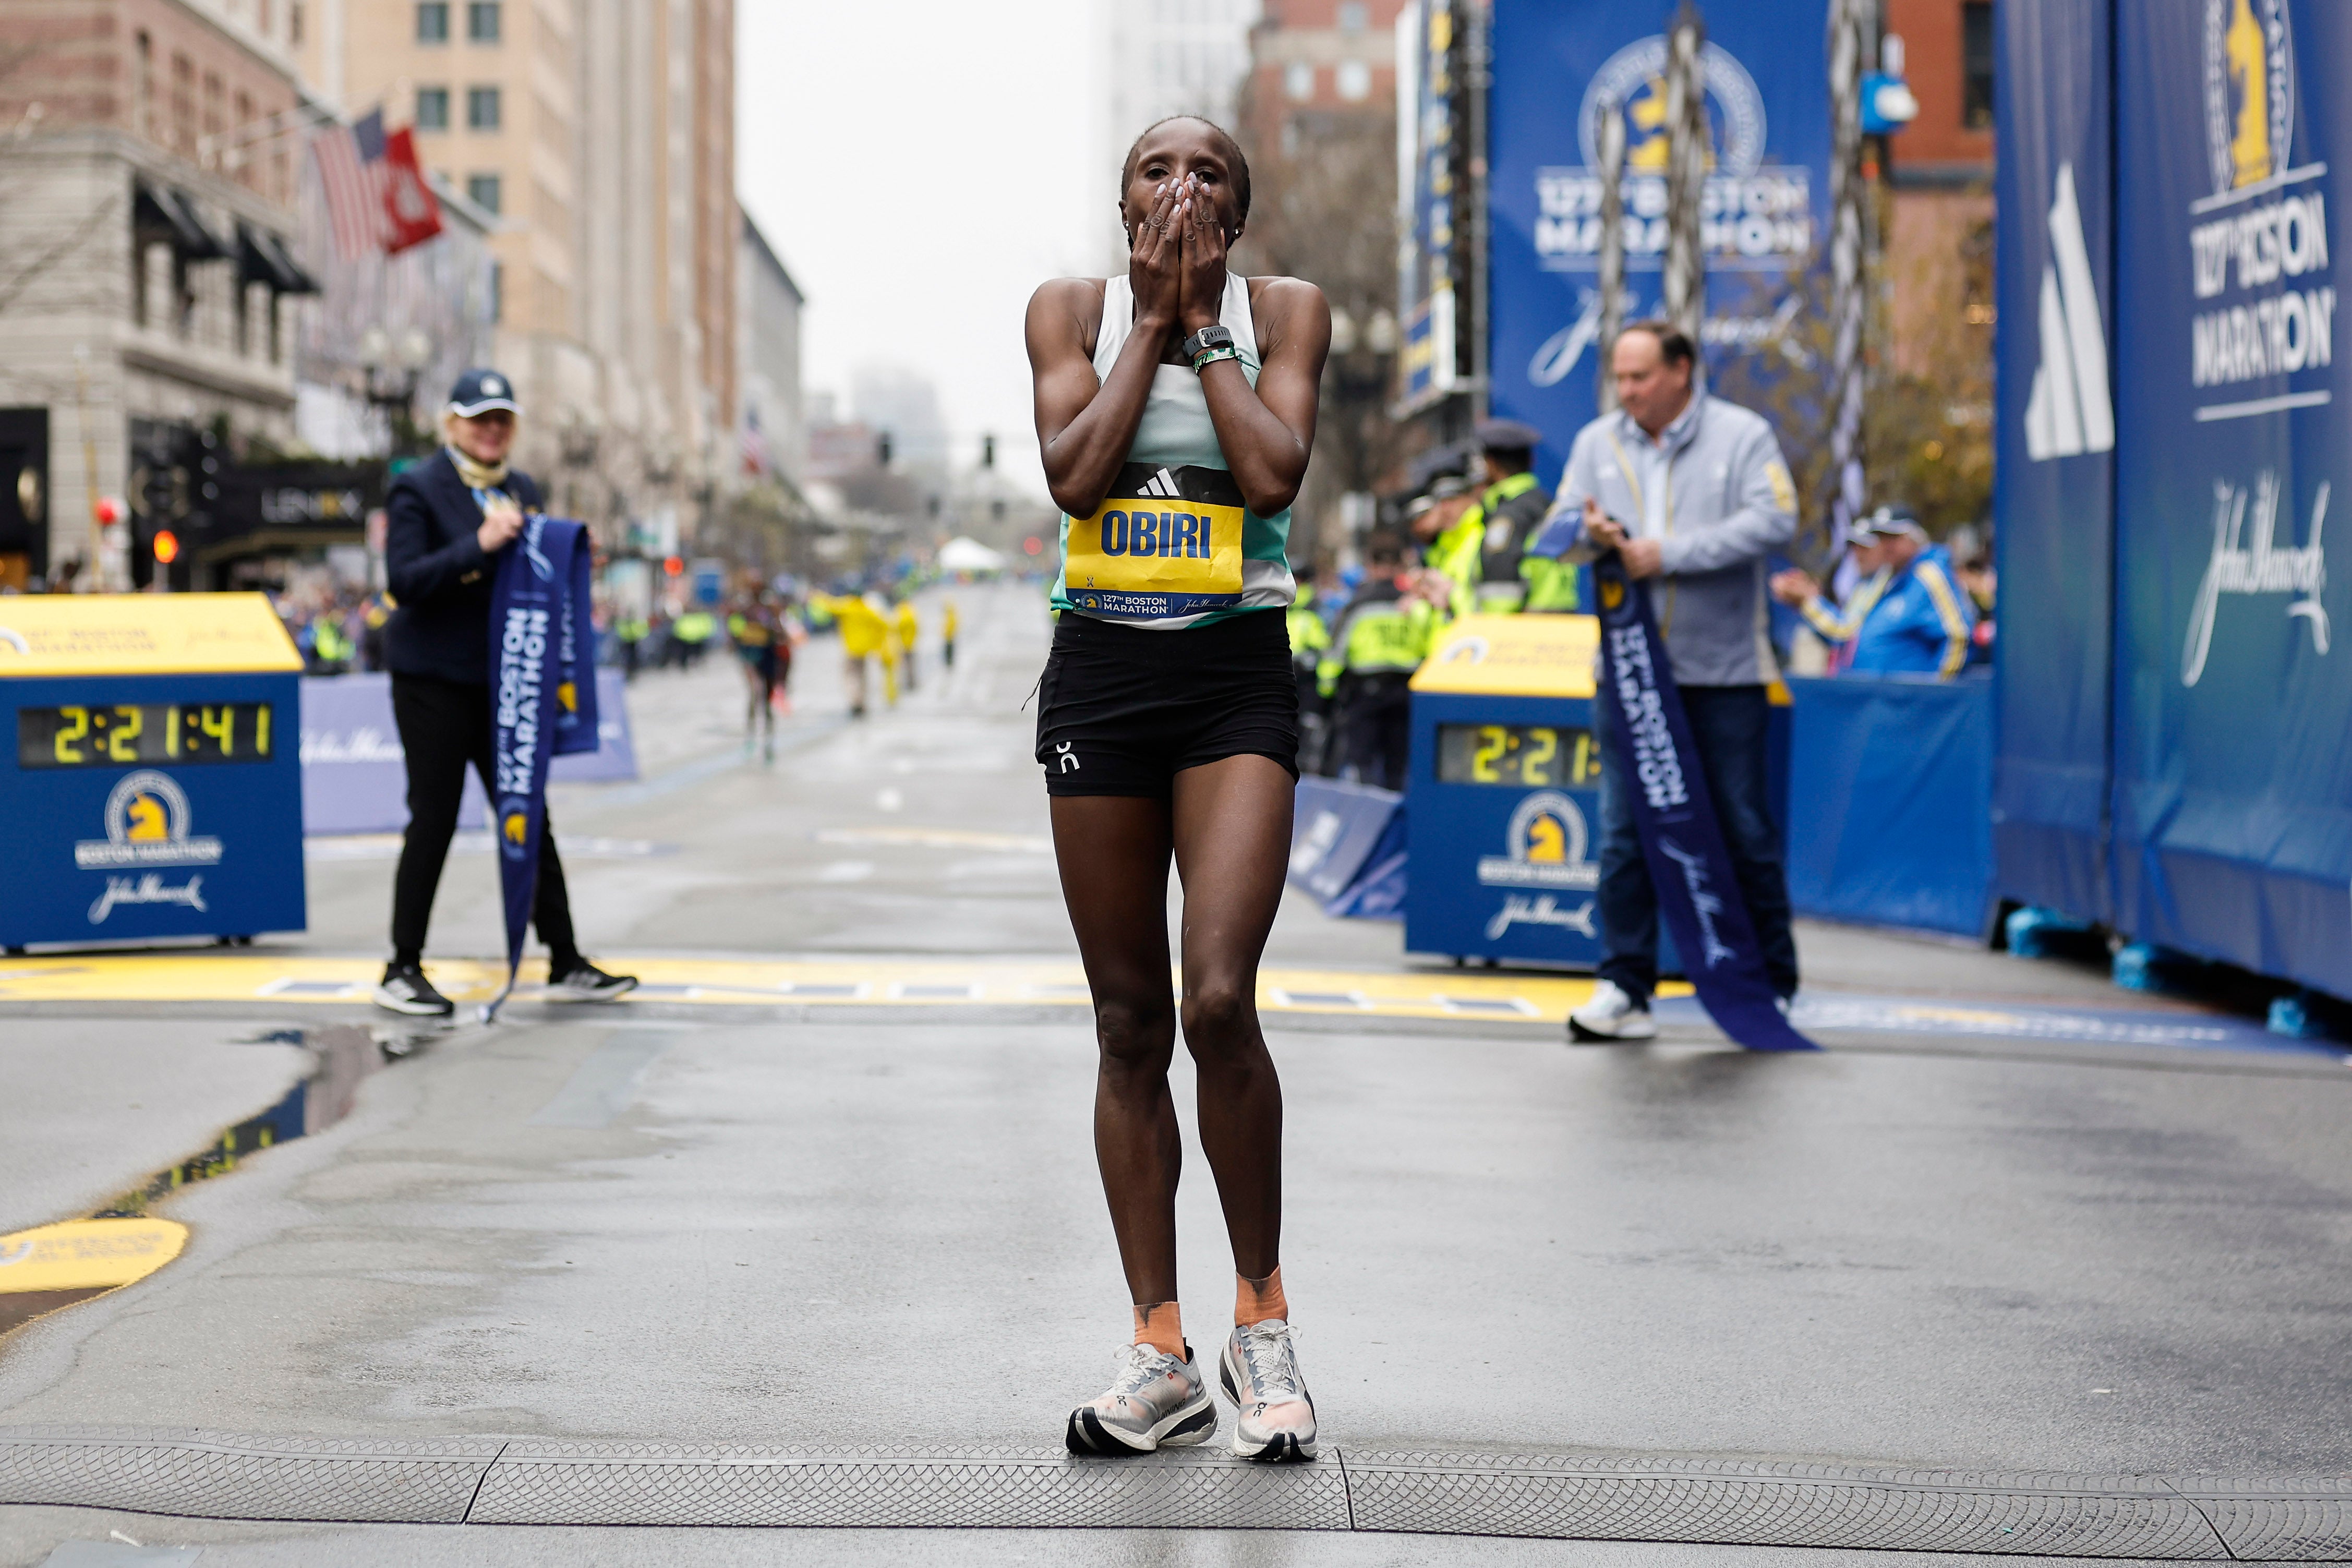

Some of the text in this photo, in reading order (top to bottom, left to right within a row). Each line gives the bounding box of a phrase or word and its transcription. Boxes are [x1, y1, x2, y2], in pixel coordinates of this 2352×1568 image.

[2192, 286, 2332, 388] MARATHON
[1101, 510, 1211, 558] OBIRI
[1104, 602, 1166, 614] MARATHON
[1125, 597, 1166, 605] BOSTON
[1178, 598, 1228, 613] John Hancock
[497, 608, 528, 728] BOSTON
[511, 609, 549, 794] MARATHON
[1610, 628, 1669, 808] MARATHON
[55, 706, 270, 763] 2:21:41
[1472, 726, 1600, 785] 2:21:
[1639, 689, 1689, 806] BOSTON
